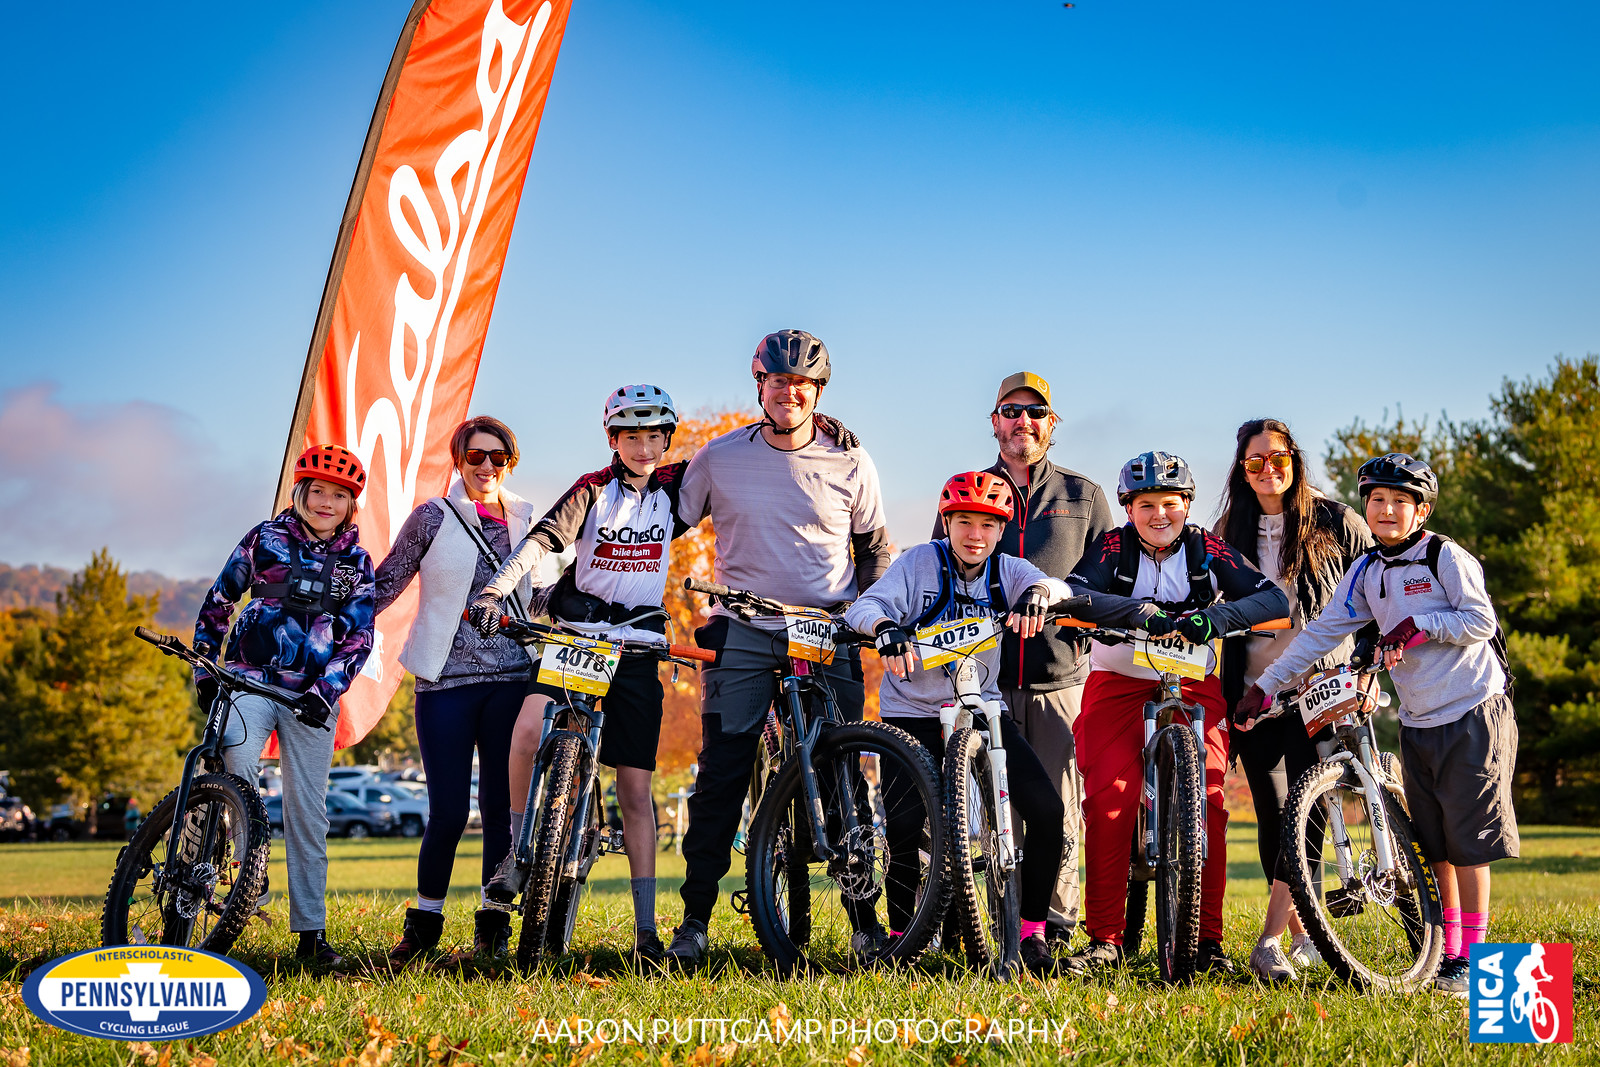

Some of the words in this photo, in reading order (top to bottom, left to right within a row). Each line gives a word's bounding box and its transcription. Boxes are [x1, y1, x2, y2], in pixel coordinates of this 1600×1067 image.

[596, 524, 665, 544] SoChesCo
[611, 547, 630, 557] bike
[631, 548, 650, 557] team
[552, 635, 568, 643] 2022
[795, 619, 832, 640] COACH
[932, 622, 980, 648] 4075
[556, 647, 607, 673] 4078
[575, 669, 600, 681] Gaulding
[1305, 678, 1341, 711] 6009
[191, 783, 224, 791] KENDA
[1411, 841, 1438, 902] MAXXIS
